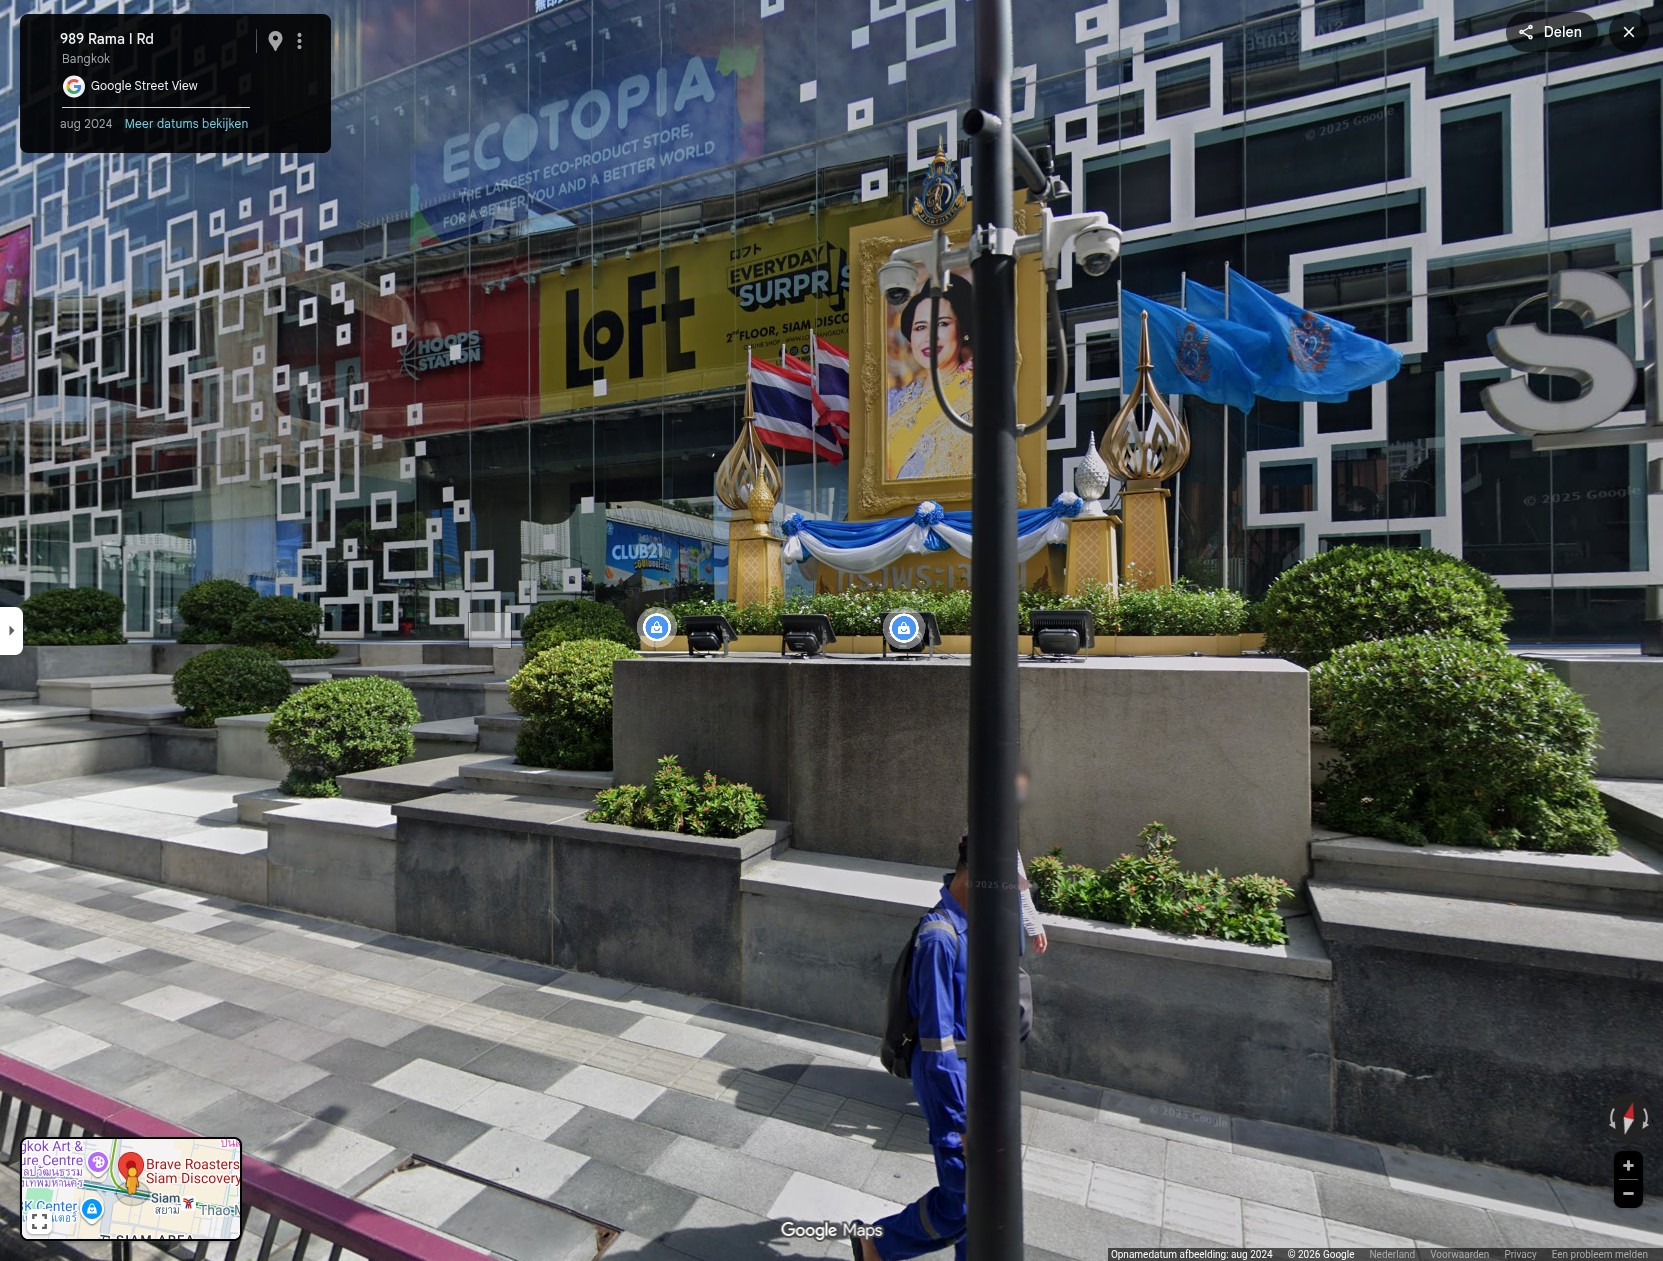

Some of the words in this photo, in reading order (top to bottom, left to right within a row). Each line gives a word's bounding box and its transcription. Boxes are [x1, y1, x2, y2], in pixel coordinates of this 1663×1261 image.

[443, 56, 716, 184] ECOTOPIA
[461, 186, 482, 203] THE
[486, 169, 540, 197] LARGEST
[543, 139, 640, 180] ECO-PRODUCT
[643, 123, 694, 149] STORE,
[443, 210, 466, 229] FOR
[470, 208, 478, 219] A
[530, 186, 555, 204] YOU
[558, 177, 587, 197] AND
[590, 173, 600, 187] A
[603, 157, 656, 183] BETTER
[660, 141, 715, 167] WORLD
[730, 243, 762, 262] ロフト
[731, 246, 824, 285] EVERYDAY
[418, 329, 481, 355] HOOPS
[739, 325, 779, 341] FLOOR,
[782, 320, 811, 334] SIAM
[612, 542, 663, 561] CLUB21
